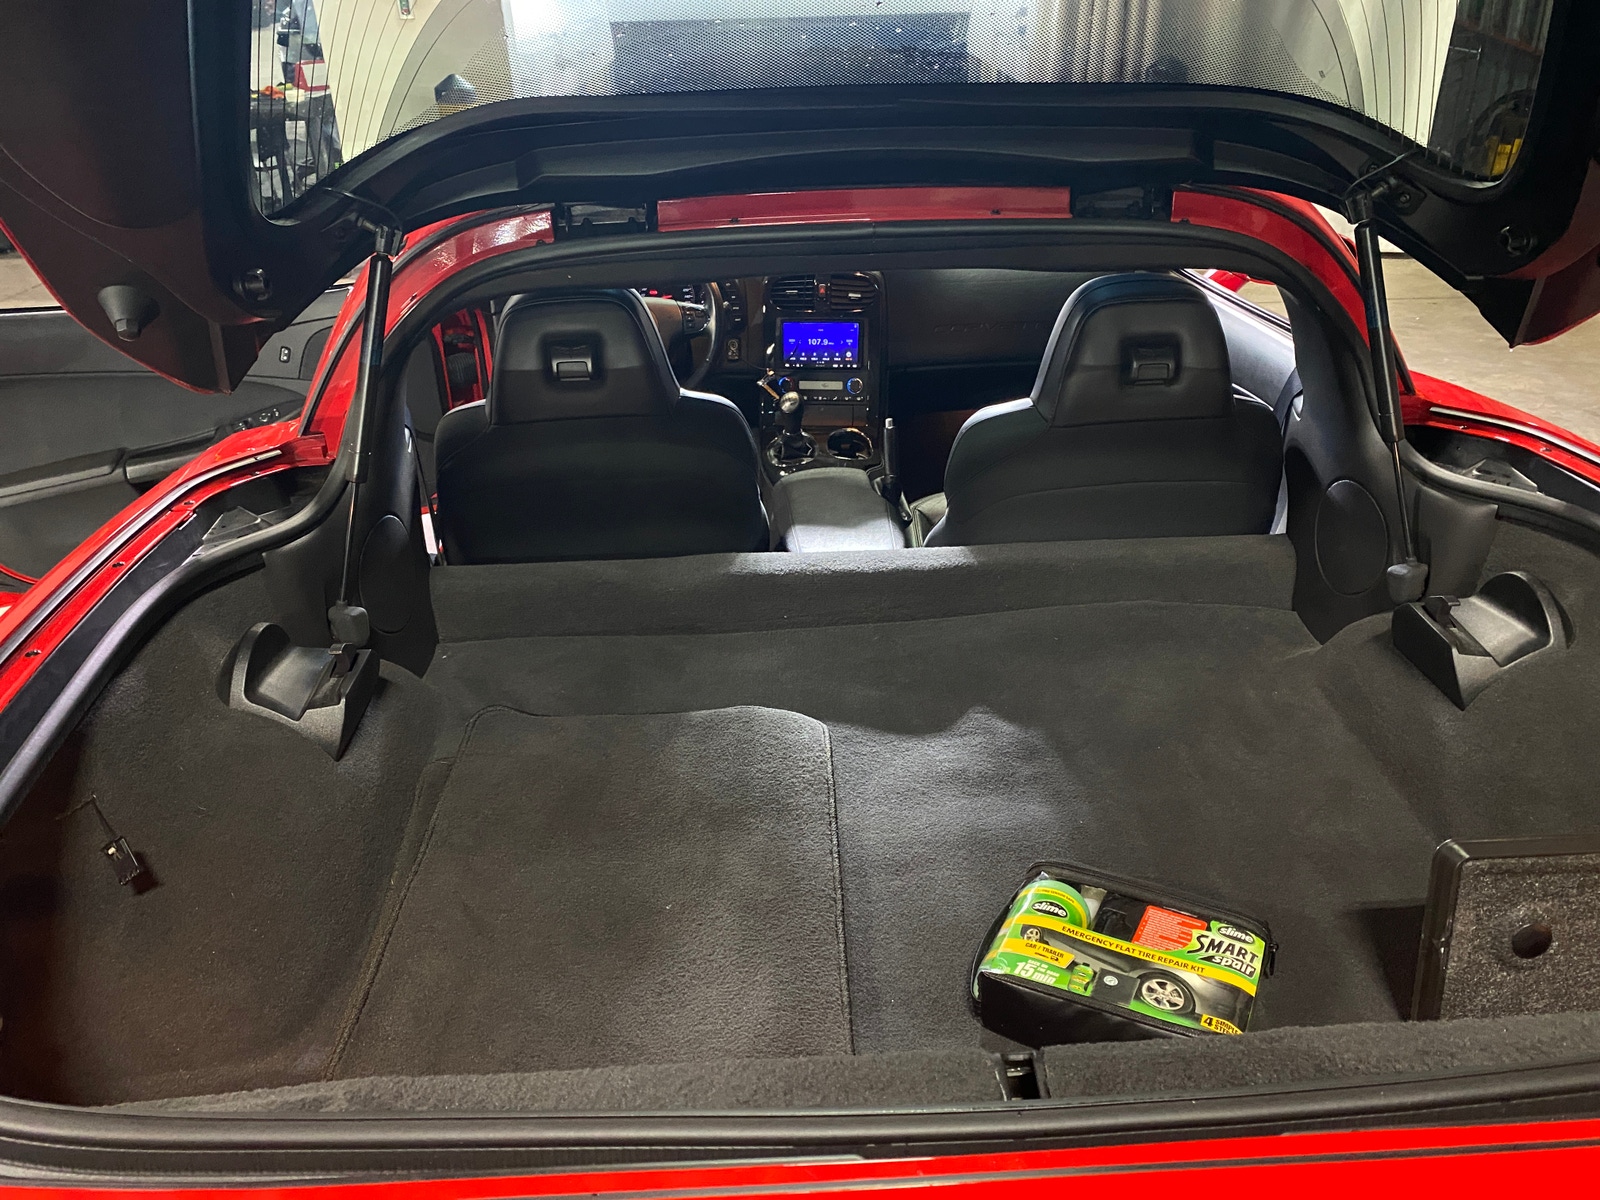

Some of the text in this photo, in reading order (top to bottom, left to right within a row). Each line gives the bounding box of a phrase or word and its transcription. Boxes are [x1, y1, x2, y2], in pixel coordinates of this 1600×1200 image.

[808, 338, 829, 346] 107.9
[1032, 900, 1067, 917] slime
[1218, 926, 1254, 943] slime
[1042, 946, 1064, 958] TRAILER
[1062, 926, 1206, 973] EMERGENCY FLAT TIRE REPAIR KIT
[1187, 934, 1258, 964] SMART
[1014, 961, 1038, 978] 15
[1032, 971, 1056, 985] min
[1213, 955, 1256, 976] spair
[1204, 1017, 1213, 1027] 4
